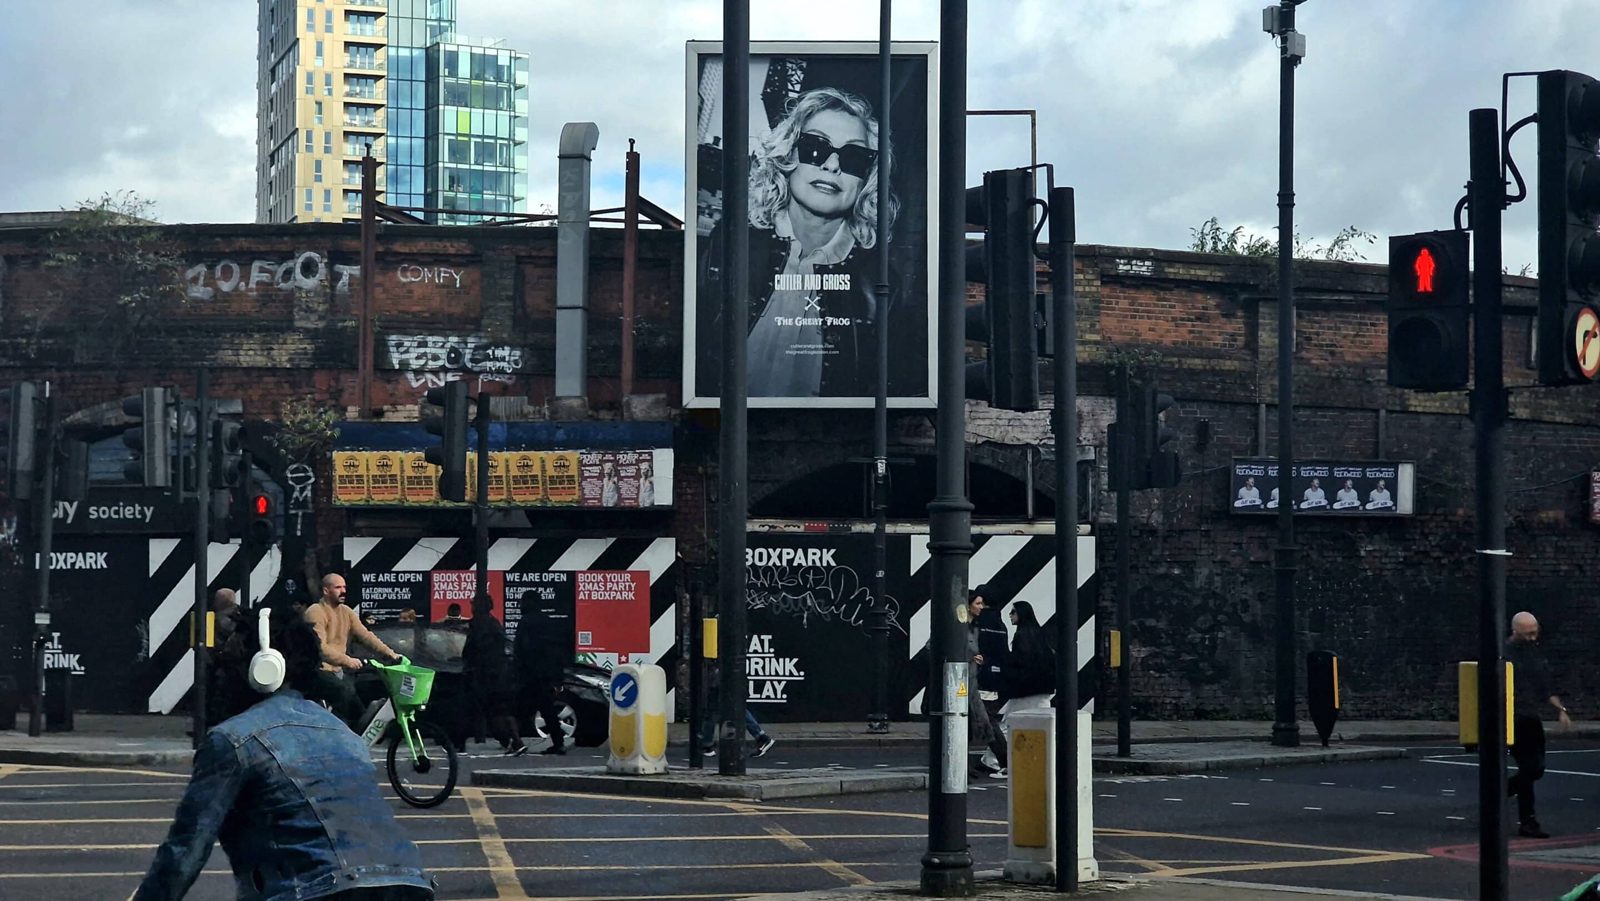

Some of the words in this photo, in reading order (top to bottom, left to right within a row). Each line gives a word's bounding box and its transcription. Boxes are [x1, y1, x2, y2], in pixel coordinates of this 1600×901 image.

[397, 264, 464, 288] COMFY
[775, 274, 802, 290] CUTLER
[804, 274, 821, 290] AND
[823, 274, 850, 290] GROSS
[89, 502, 154, 523] society
[362, 573, 376, 582] WE
[378, 573, 396, 582] ARE
[398, 573, 423, 582] OPEN
[433, 573, 459, 582] BOOK
[505, 573, 520, 582] WE
[522, 573, 540, 582] ARE
[542, 573, 567, 582] OPEN
[578, 573, 603, 582] BOOK
[605, 573, 631, 582] YOUR
[434, 582, 460, 590] XMAS
[578, 583, 604, 591] XMAS
[607, 583, 636, 591] PARTY
[433, 591, 445, 599] AT
[578, 591, 590, 600] AT
[591, 591, 635, 600] BOXPARK
[746, 634, 775, 653] AT.
[44, 653, 85, 671] RINK.
[748, 680, 787, 699] LAY.
